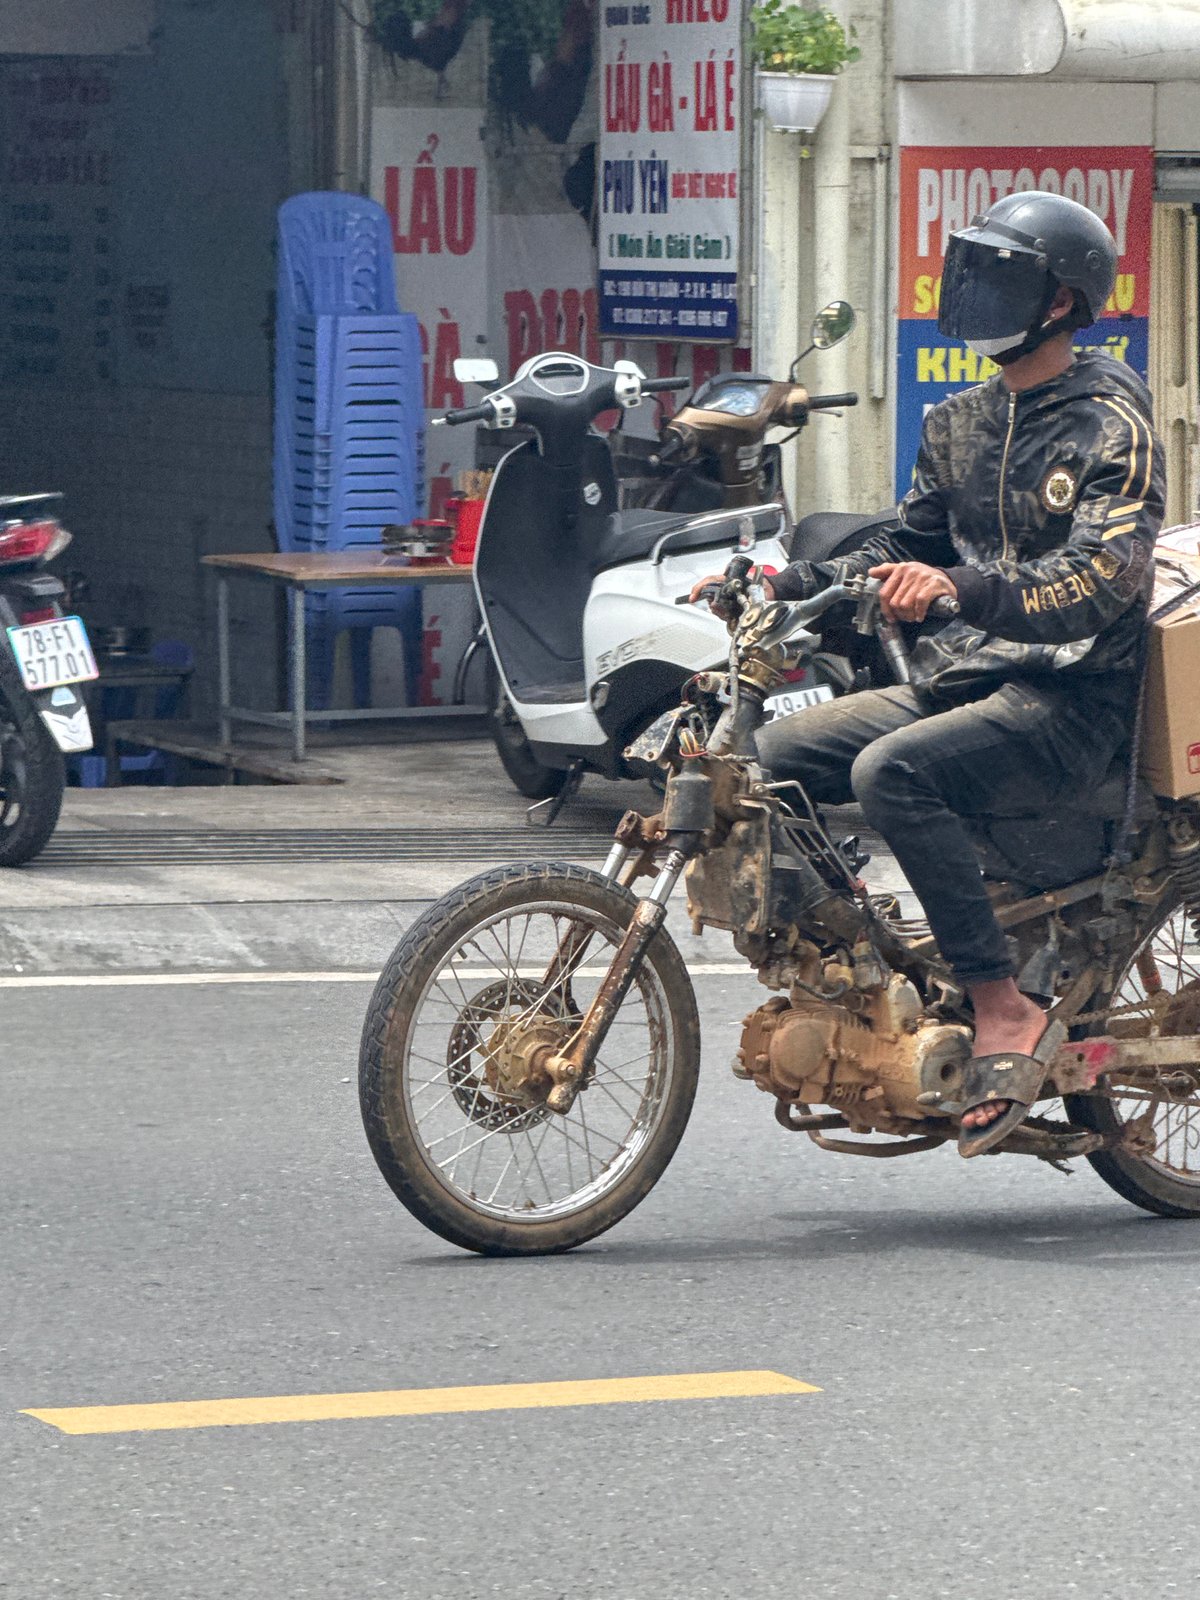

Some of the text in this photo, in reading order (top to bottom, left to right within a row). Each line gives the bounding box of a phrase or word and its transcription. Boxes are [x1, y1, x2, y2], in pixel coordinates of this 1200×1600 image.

[647, 50, 674, 132] GÀ
[694, 49, 717, 132] LÁ
[724, 48, 735, 132] É
[385, 133, 477, 255] LẨU
[603, 150, 634, 214] PHÚ
[638, 149, 668, 214] YÊN
[22, 624, 76, 657] 78-F1
[24, 650, 92, 685] 577.01
